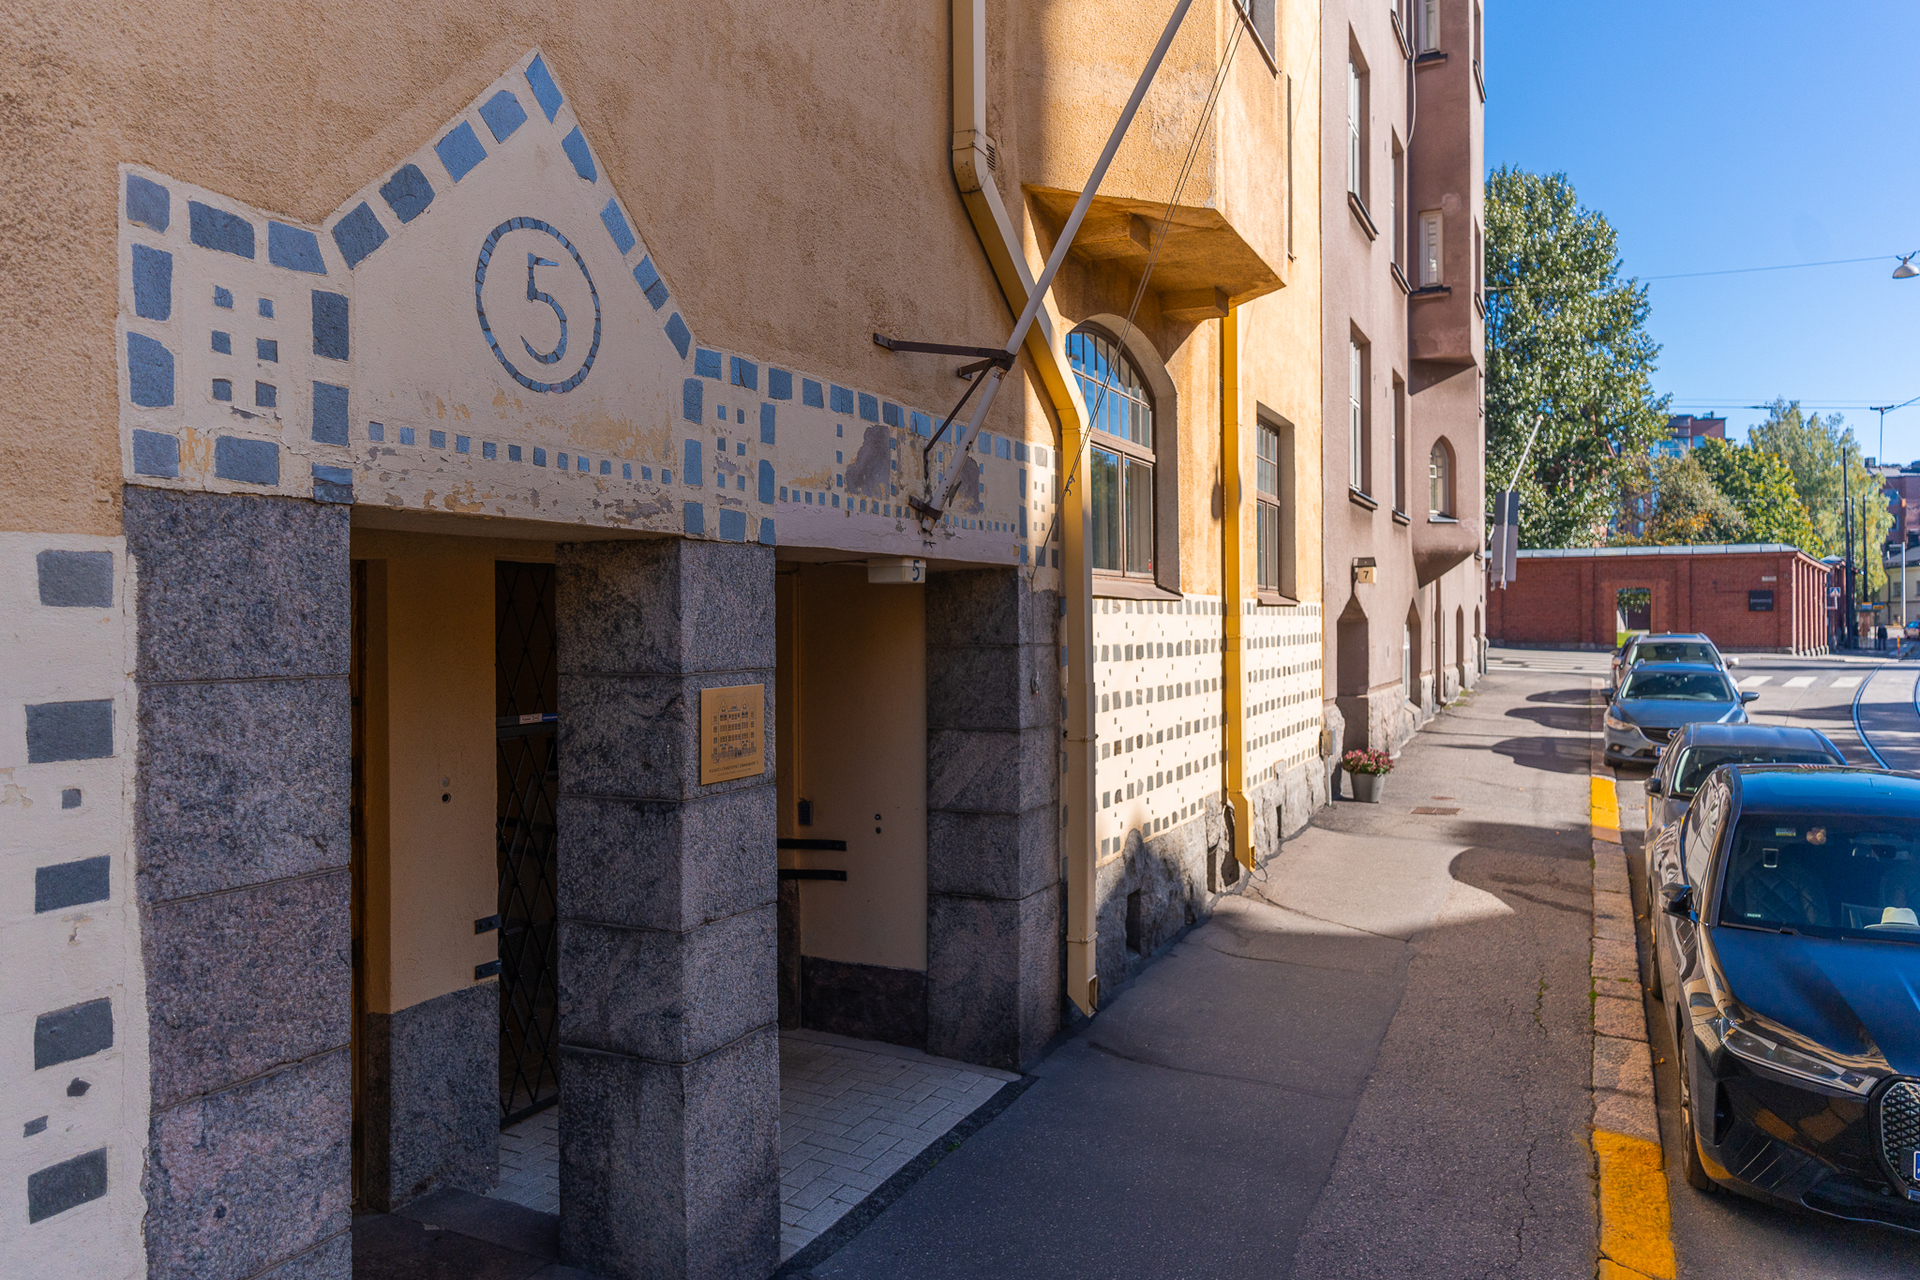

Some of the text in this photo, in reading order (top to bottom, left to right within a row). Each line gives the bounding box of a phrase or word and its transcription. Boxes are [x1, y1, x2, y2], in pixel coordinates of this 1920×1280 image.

[520, 252, 568, 365] 5
[912, 559, 920, 582] 5
[1363, 570, 1369, 579] 7
